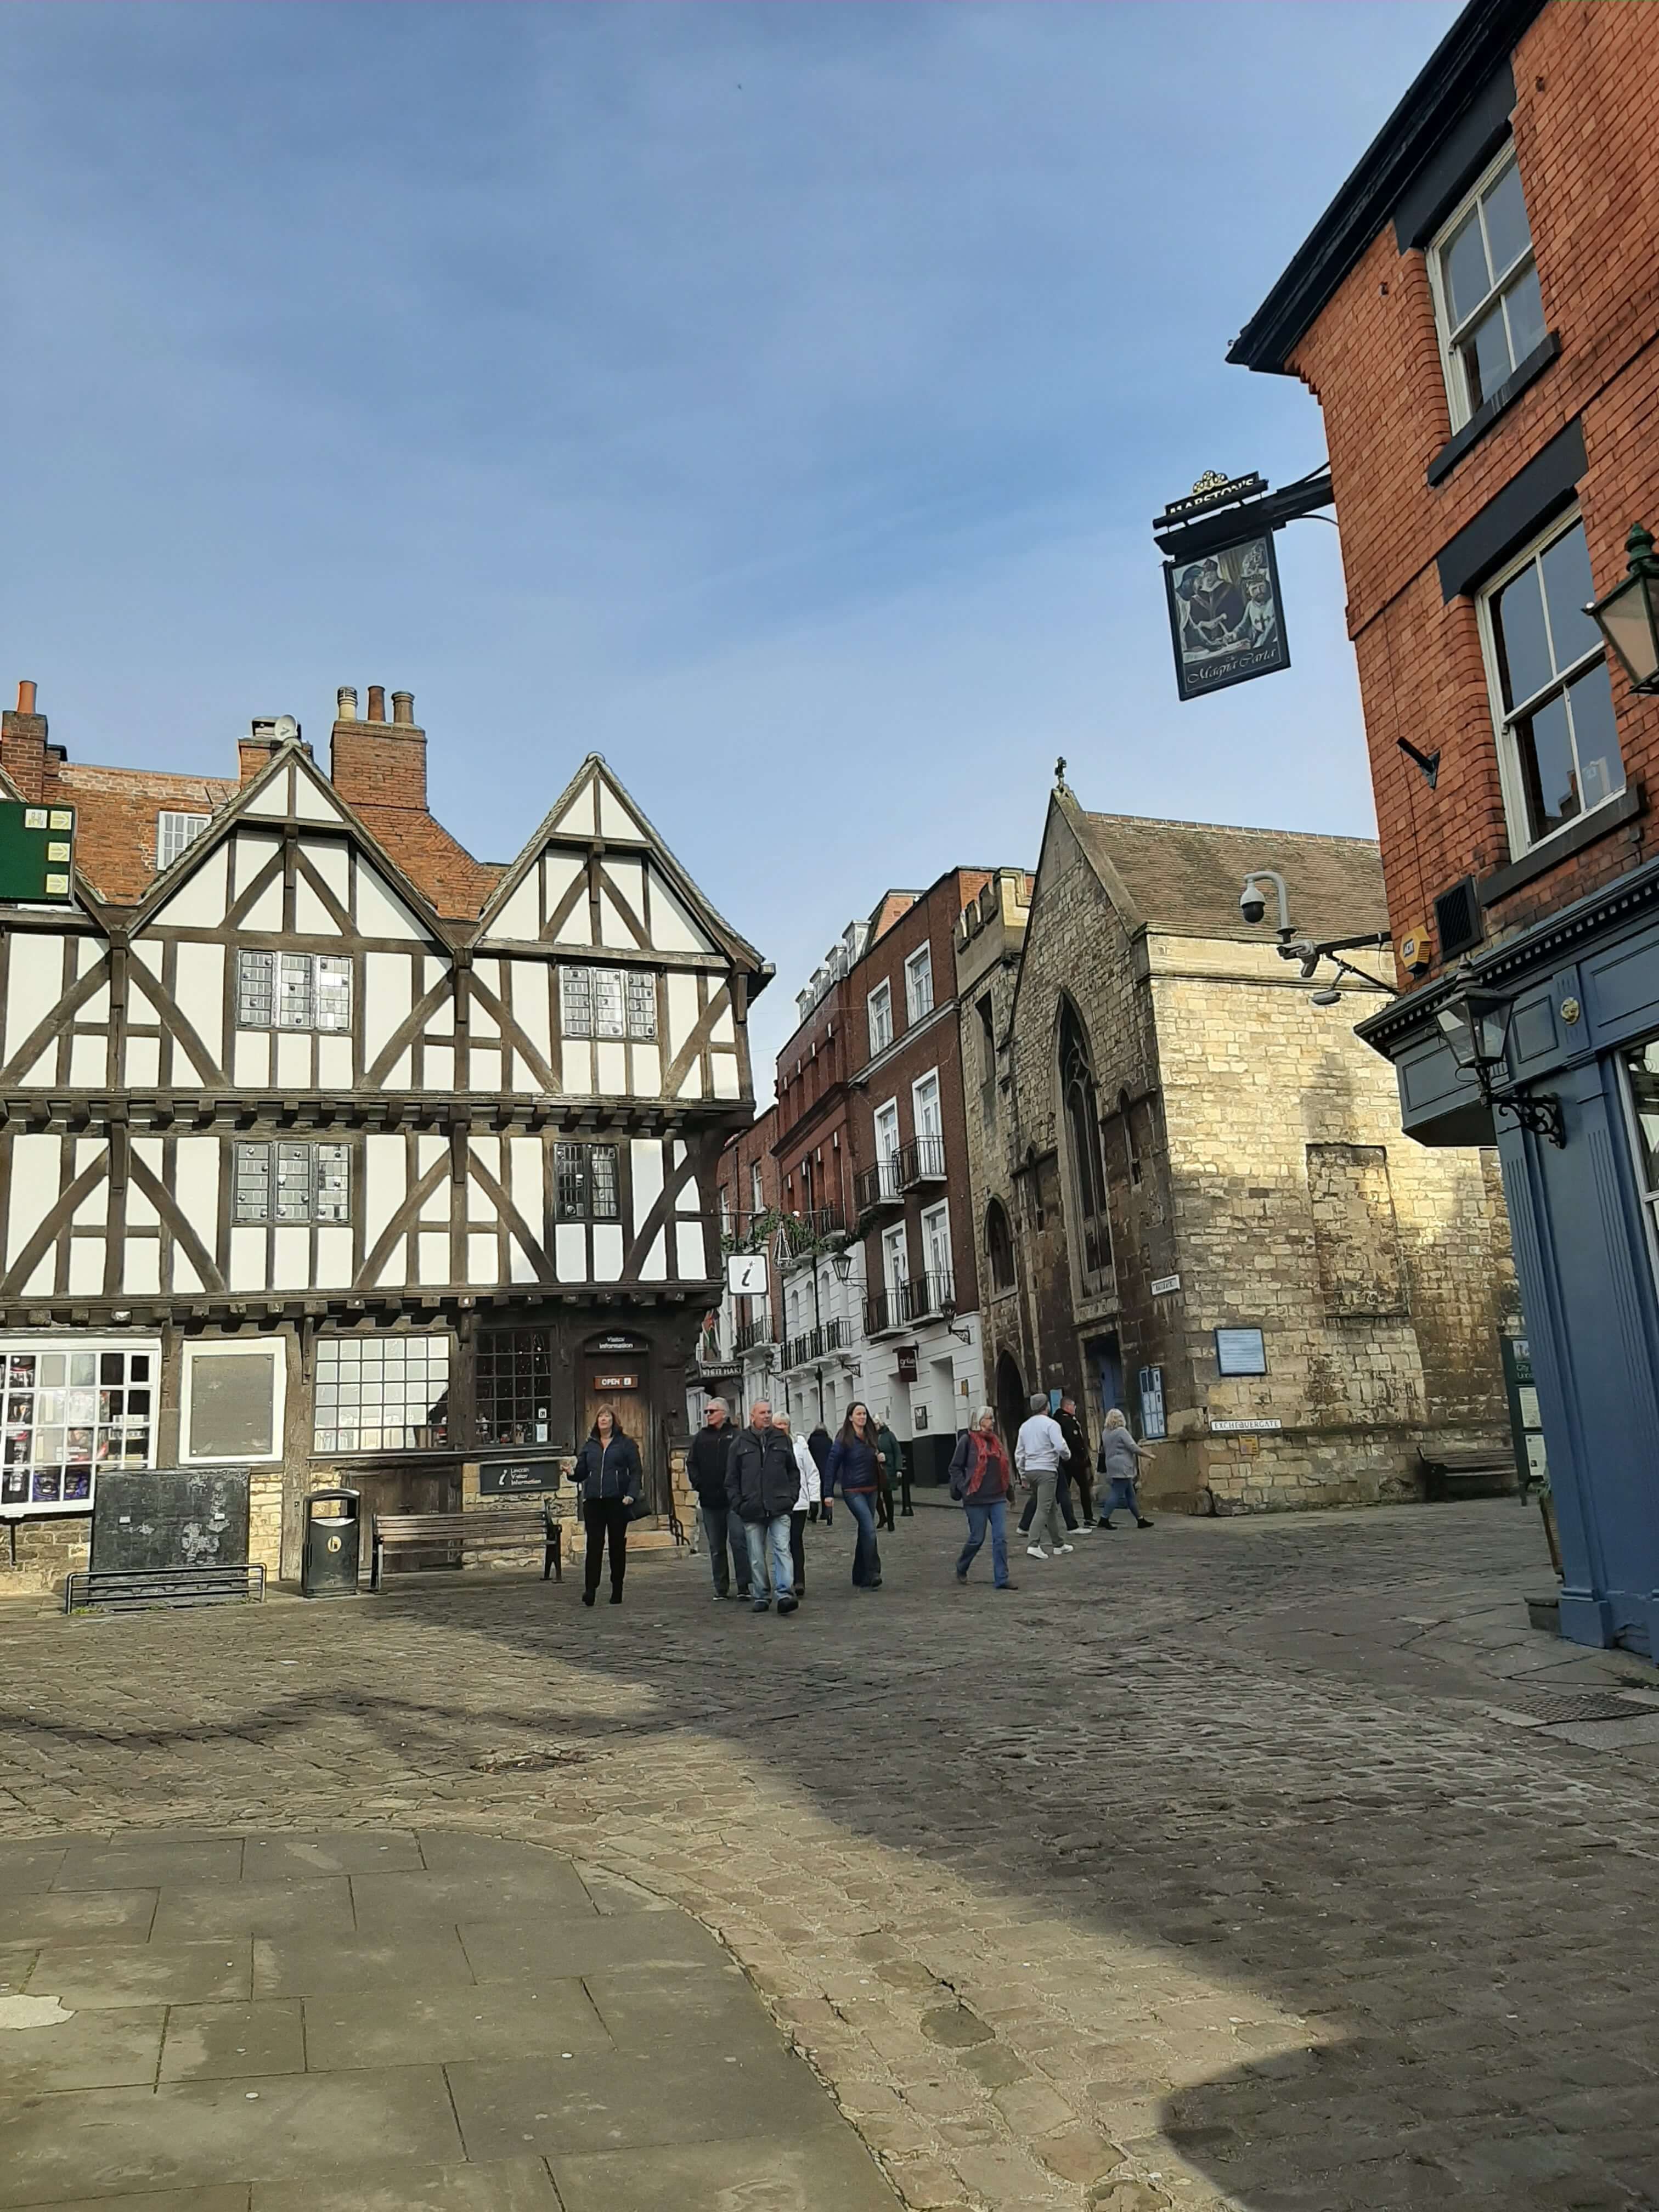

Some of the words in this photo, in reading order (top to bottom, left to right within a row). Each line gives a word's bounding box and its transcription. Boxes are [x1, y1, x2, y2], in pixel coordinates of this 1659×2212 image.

[1187, 660, 1238, 684] Magna
[1239, 648, 1277, 668] Carta
[1214, 1420, 1279, 1430] EXCHEQUERGATE
